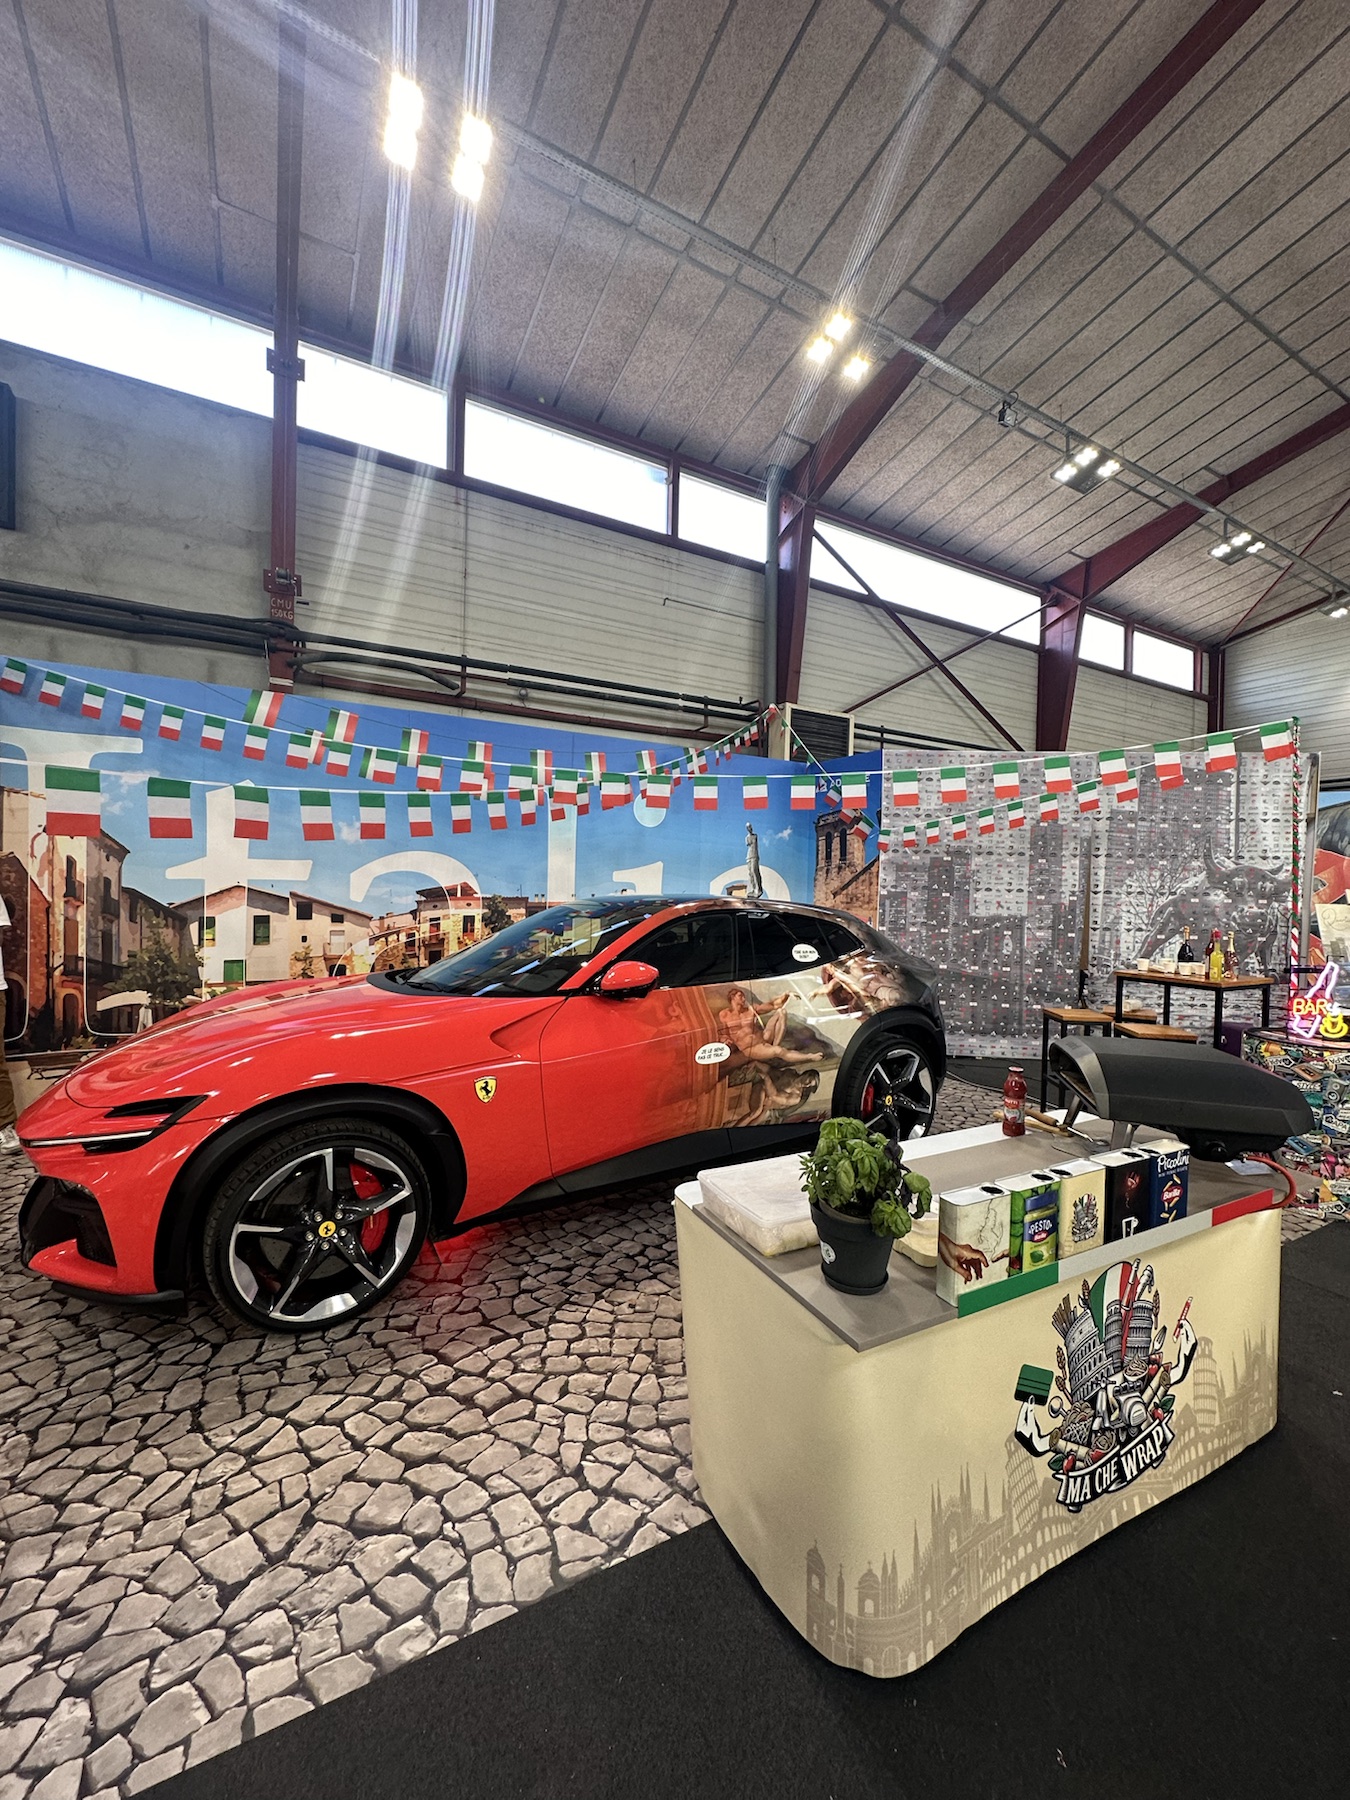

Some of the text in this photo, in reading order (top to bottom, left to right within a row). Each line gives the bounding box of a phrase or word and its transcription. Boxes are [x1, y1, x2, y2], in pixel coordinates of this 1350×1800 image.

[271, 598, 292, 609] CMU
[271, 609, 294, 620] 150KG
[1293, 998, 1327, 1015] BAR
[1157, 1150, 1190, 1173] Piccolini
[1030, 1219, 1051, 1235] PESTO
[1065, 1425, 1165, 1504] MA CHE WRAP
